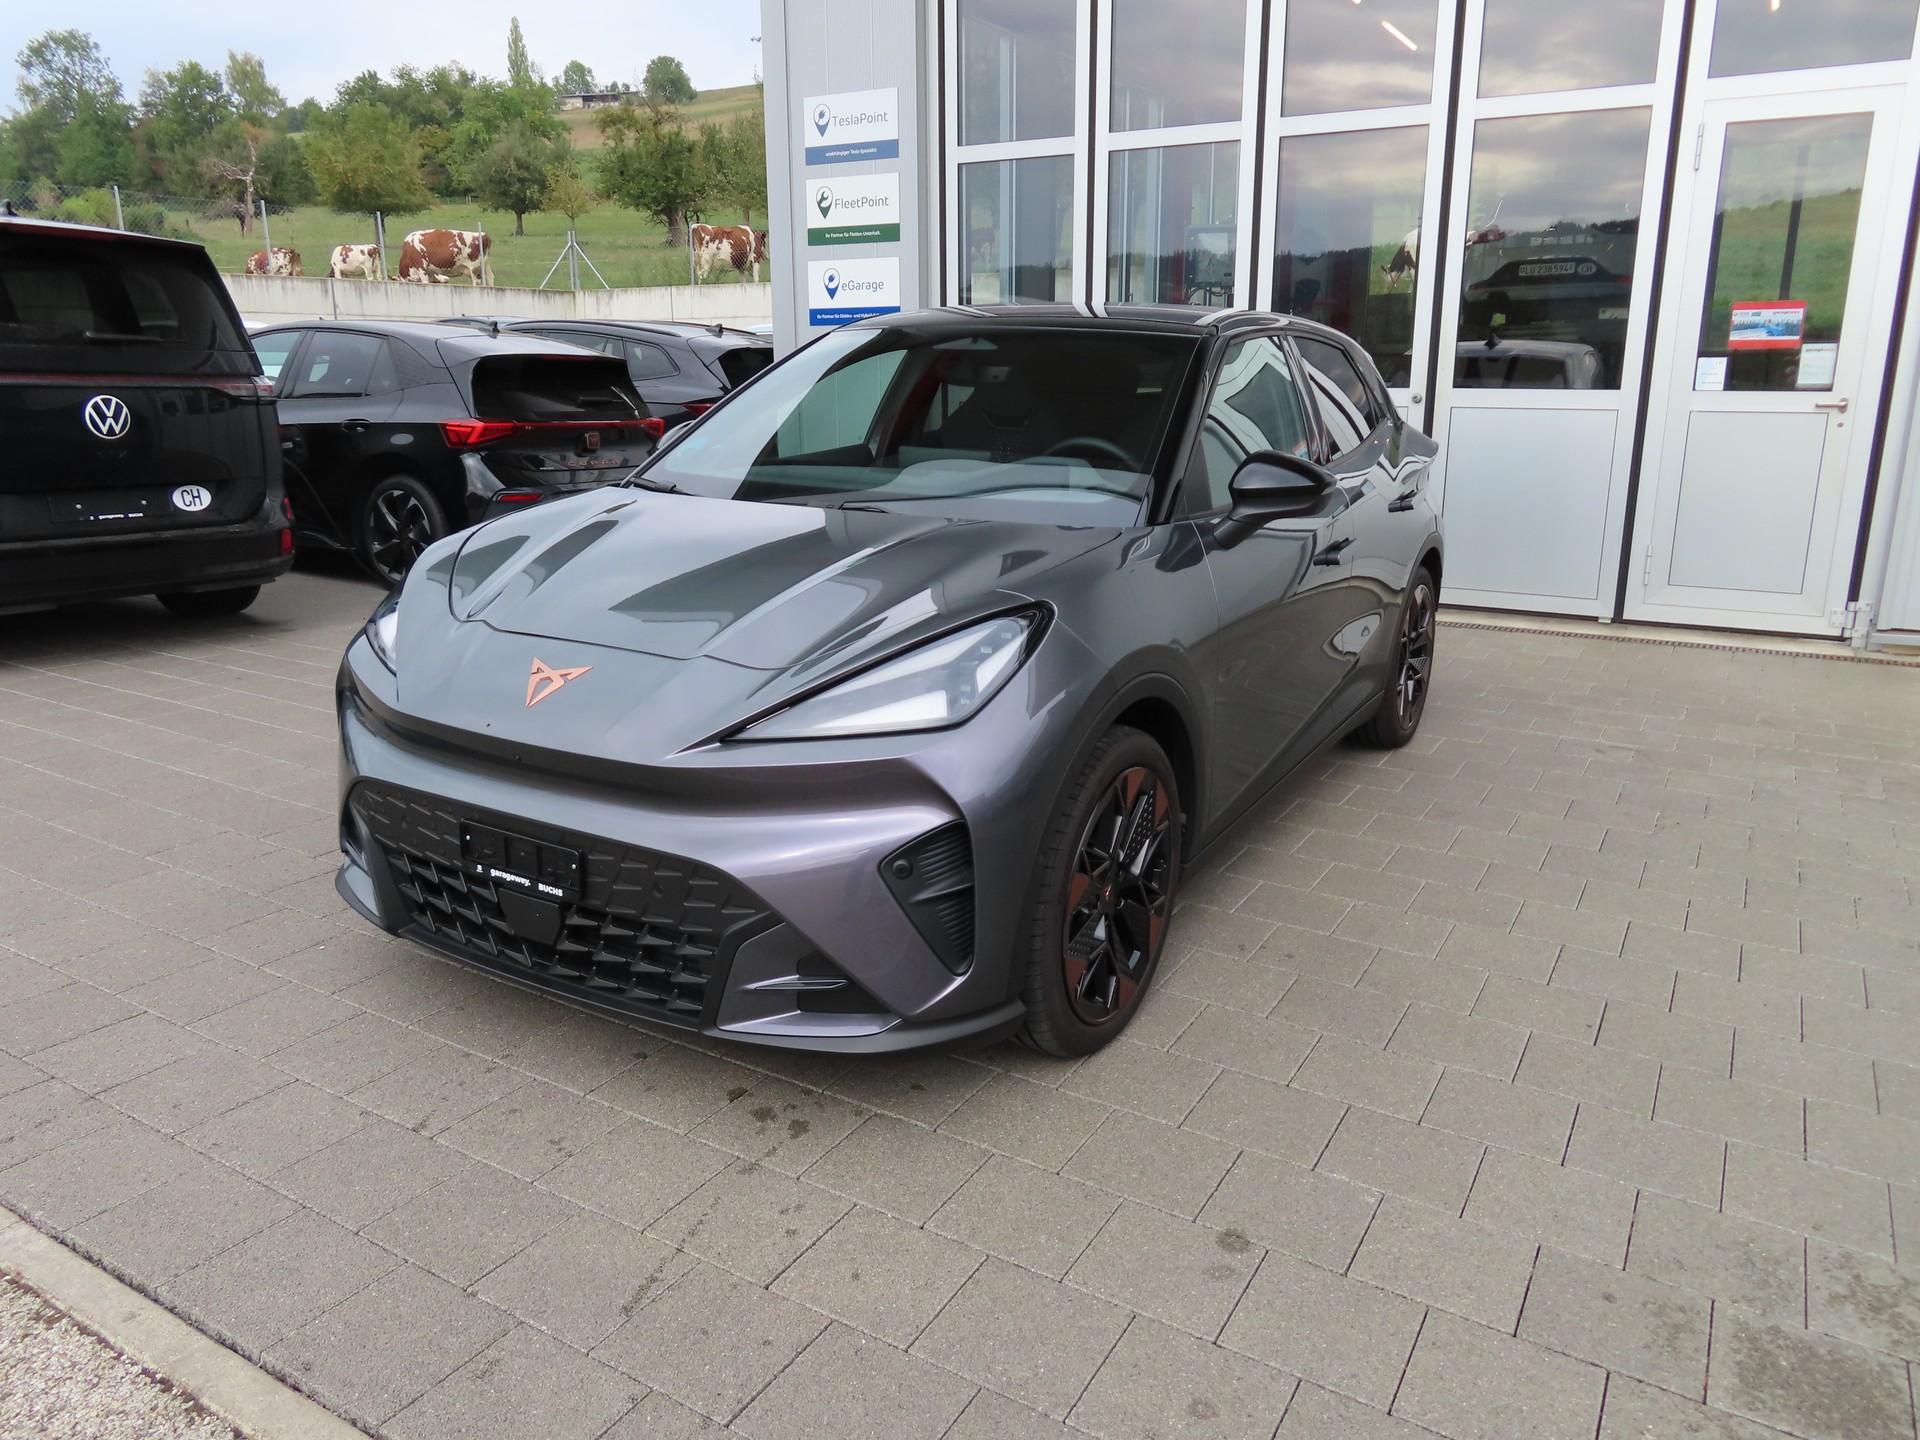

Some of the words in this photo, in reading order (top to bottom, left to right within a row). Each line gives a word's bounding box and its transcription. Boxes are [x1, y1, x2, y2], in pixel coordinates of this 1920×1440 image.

[832, 112, 888, 127] TeslaPoint
[834, 195, 889, 209] FleetPoint
[842, 280, 884, 292] eGarage
[180, 488, 204, 507] CH
[538, 882, 564, 897] BUCHS
